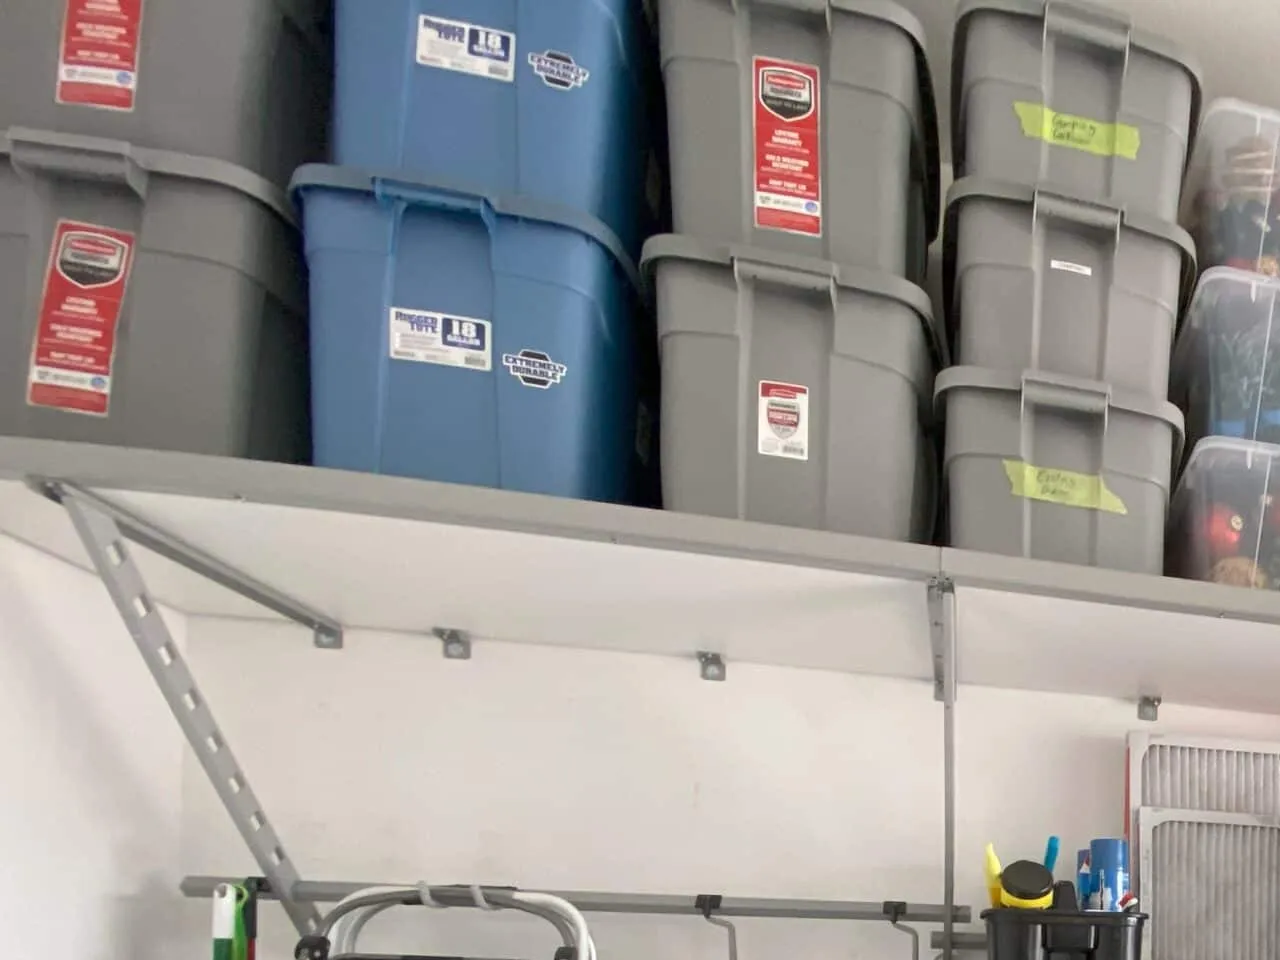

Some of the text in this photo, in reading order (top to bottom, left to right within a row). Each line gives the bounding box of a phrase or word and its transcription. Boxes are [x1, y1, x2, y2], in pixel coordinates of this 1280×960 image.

[477, 29, 502, 50] 18
[530, 54, 589, 78] EXTREMELY
[537, 64, 581, 83] DURABLE
[395, 311, 438, 327] RUGGED
[450, 321, 476, 338] 18
[504, 356, 565, 374] EXTREMELY
[512, 365, 559, 380] DURABLE
